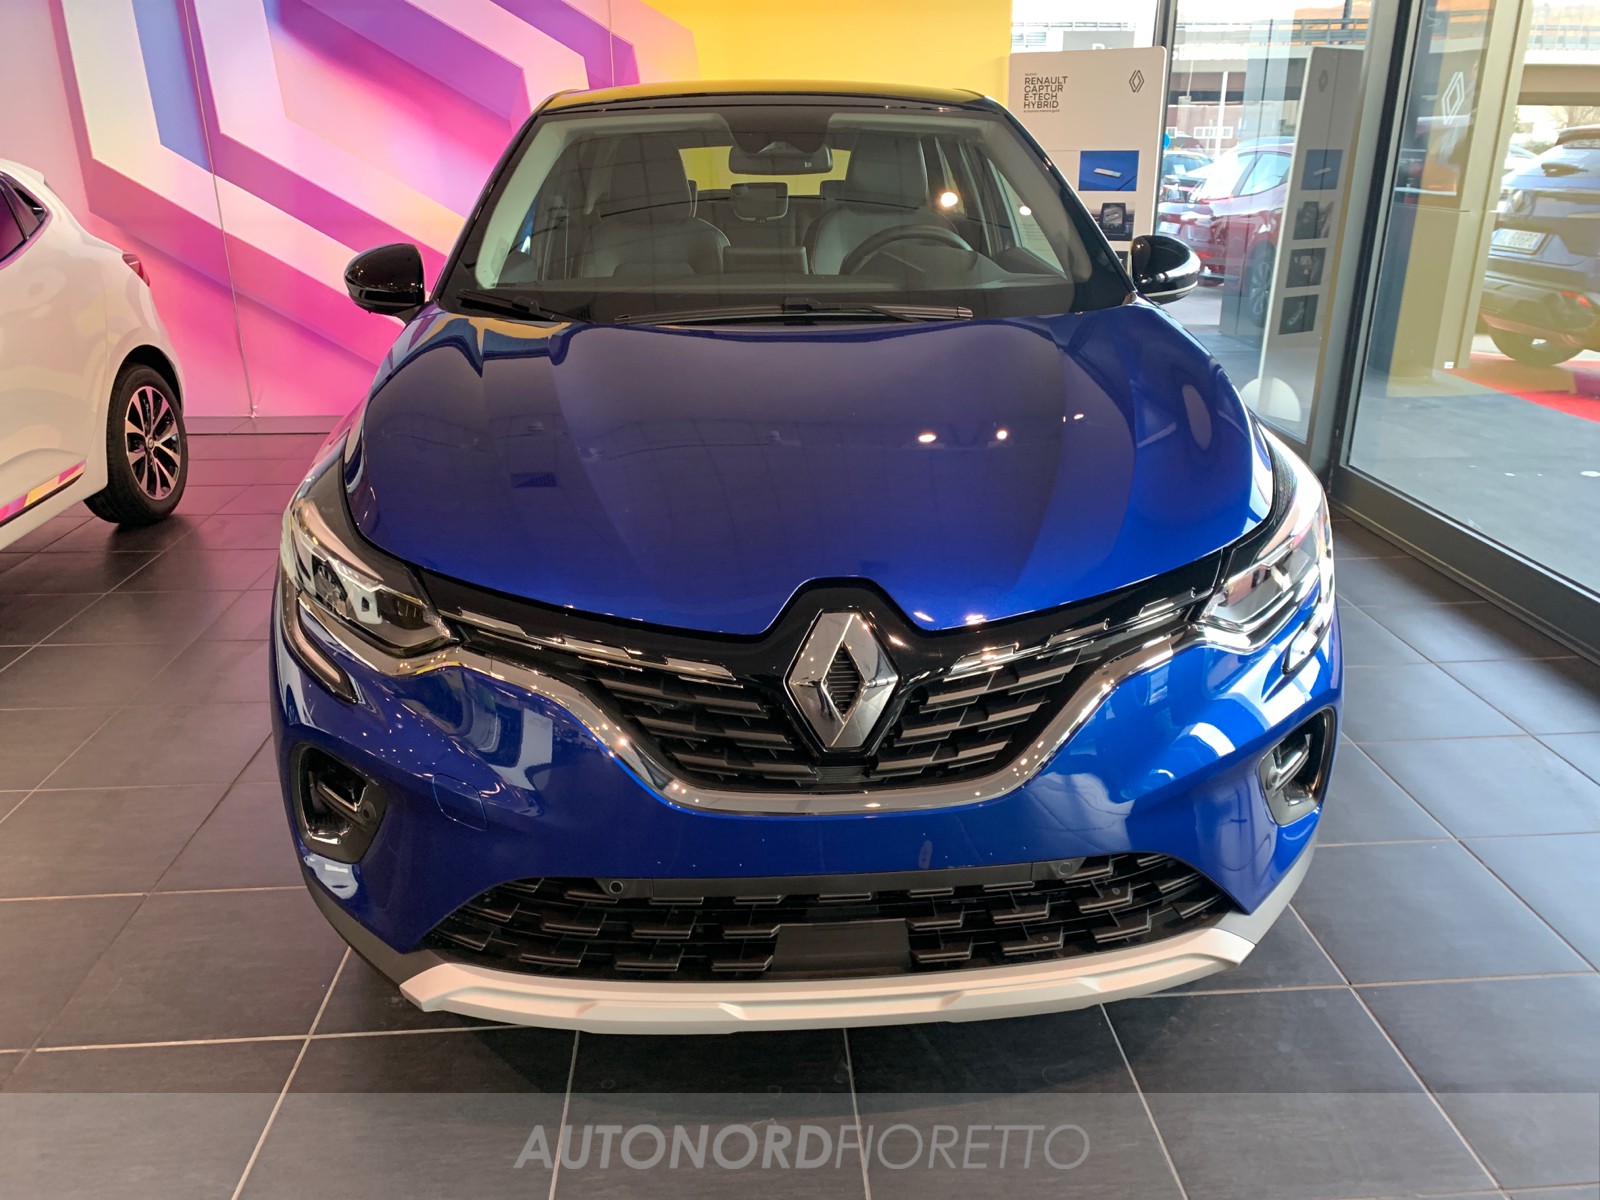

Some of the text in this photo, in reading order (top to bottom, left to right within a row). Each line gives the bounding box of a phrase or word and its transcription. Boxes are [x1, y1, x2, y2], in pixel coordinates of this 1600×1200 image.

[1025, 76, 1068, 85] RENAULT
[1024, 85, 1063, 93] CAPTUR
[1024, 93, 1057, 101] E-TECH
[1024, 101, 1059, 109] HYBRID
